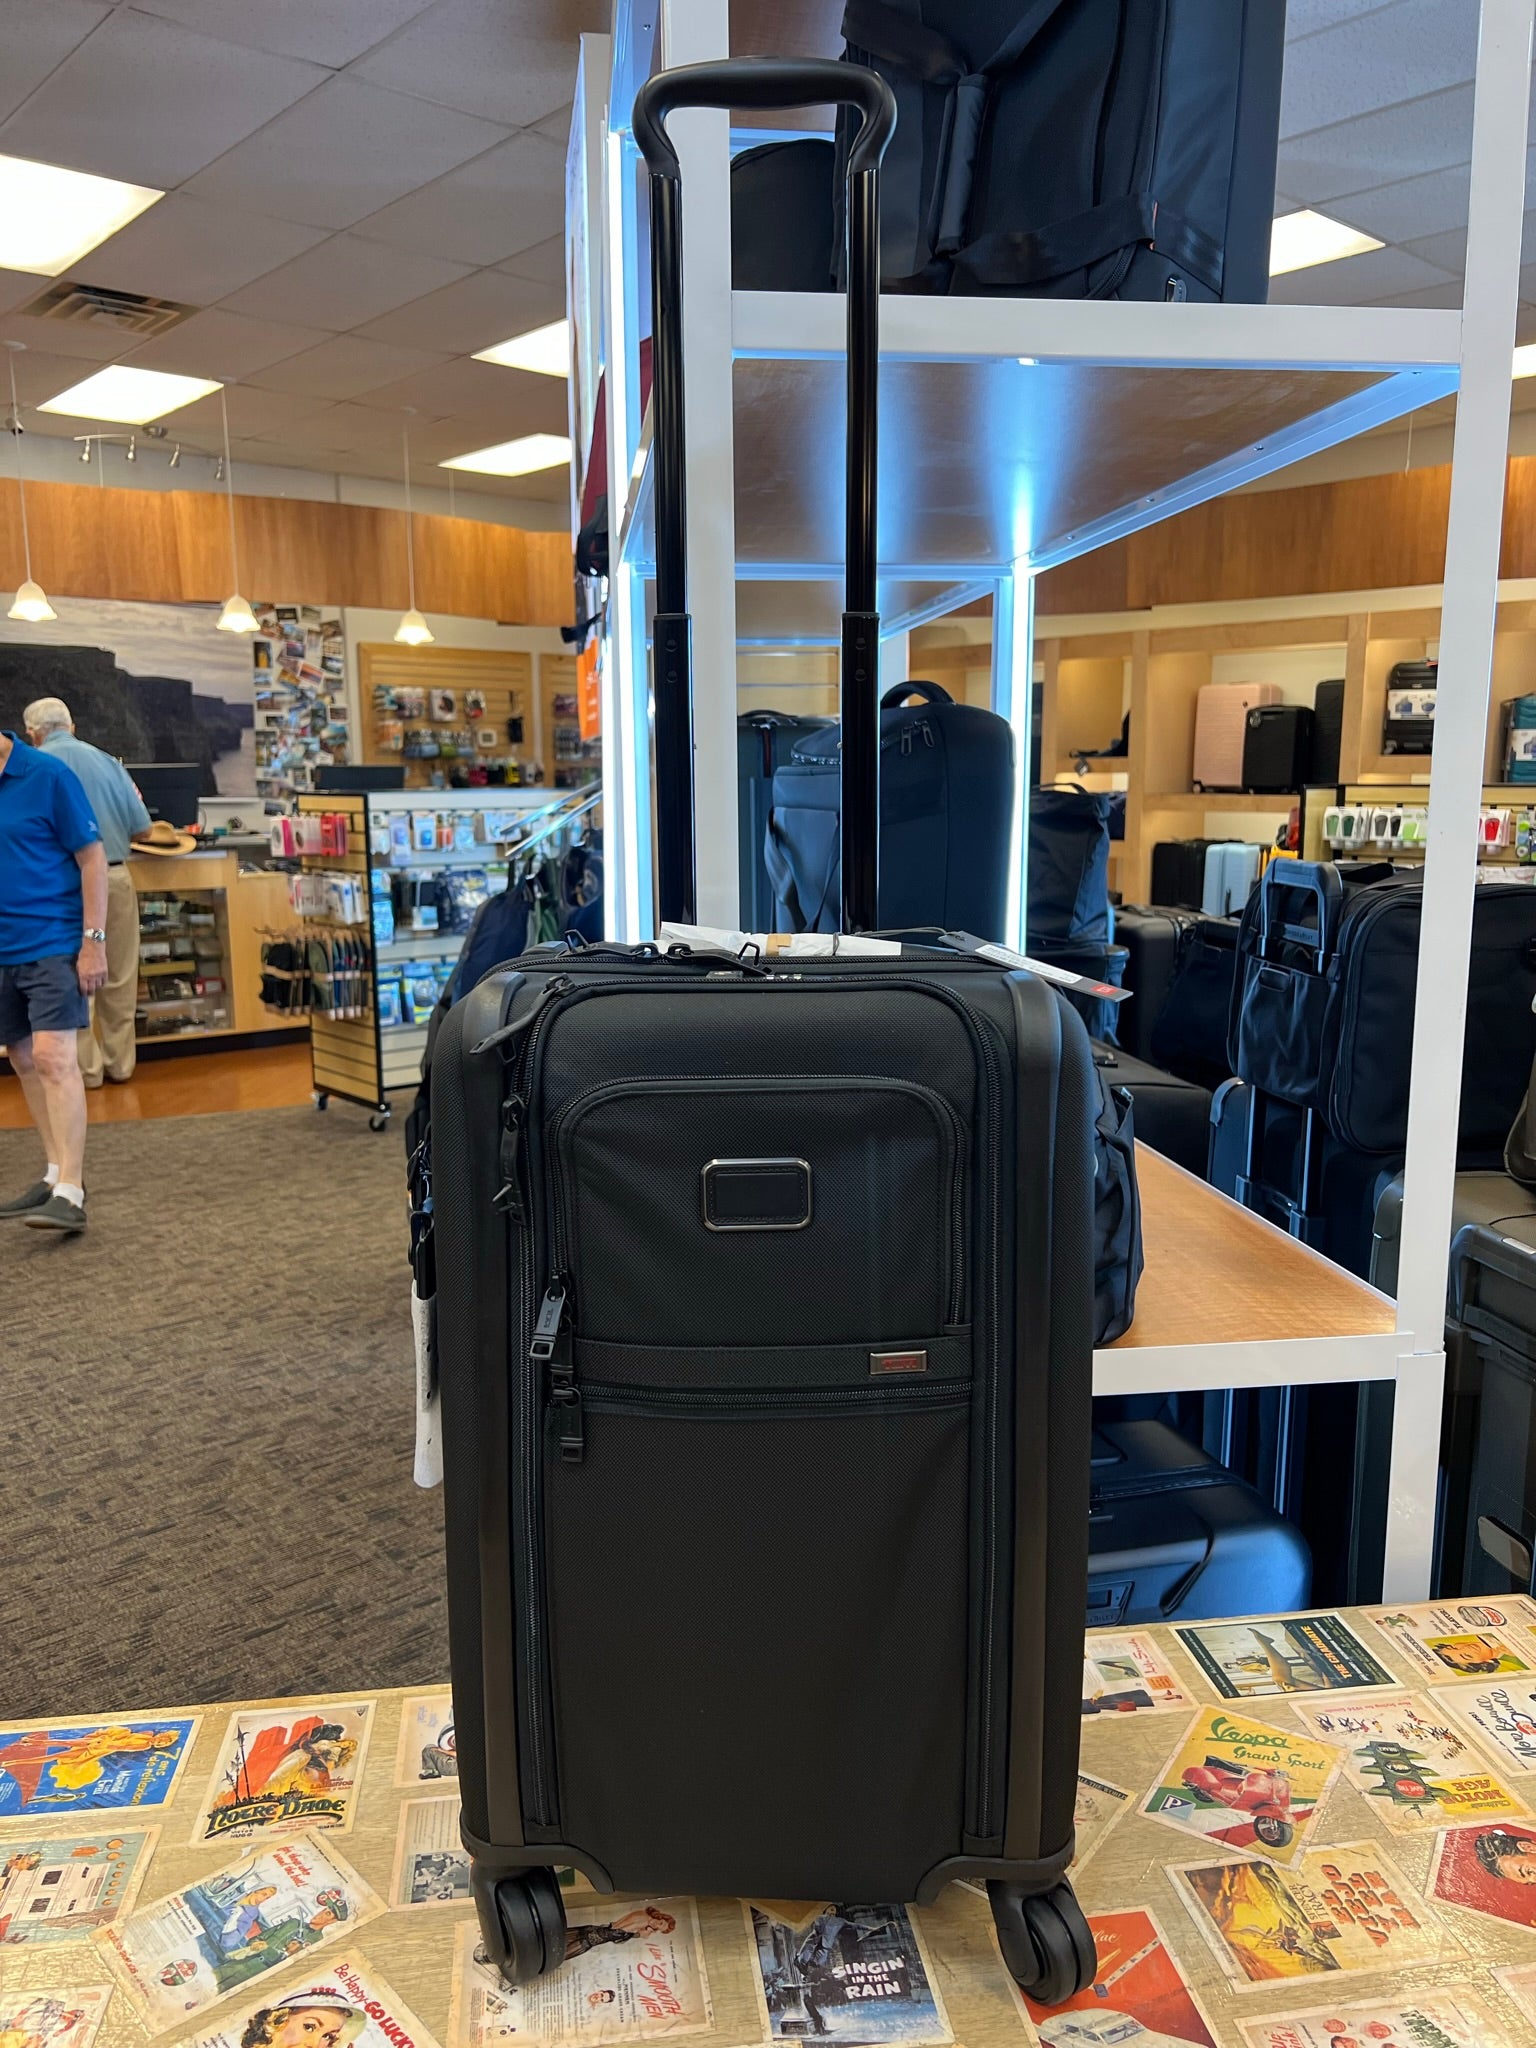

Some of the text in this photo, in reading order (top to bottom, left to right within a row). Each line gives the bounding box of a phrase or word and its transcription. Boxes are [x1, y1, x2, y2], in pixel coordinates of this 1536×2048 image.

[1301, 1625, 1340, 1663] GRADUATE
[1333, 1663, 1353, 1679] THE
[1206, 1716, 1290, 1748] Vespa
[150, 1747, 181, 1761] 7
[1232, 1746, 1326, 1770] Grand Sport
[1443, 1790, 1506, 1805] MOTOR
[1451, 1779, 1490, 1791] AGE
[1289, 1884, 1317, 1920] SPENCER
[1296, 1882, 1329, 1918] TRACY
[1321, 1864, 1389, 1948] VIEJO
[1321, 1889, 1355, 1925] EL
[1348, 1872, 1400, 1933] Y EL
[1363, 1870, 1421, 1929] MAR
[831, 1955, 906, 1979] SINGIN'
[851, 1973, 889, 1983] IN THE
[845, 1981, 901, 1999] RAIN
[334, 1963, 350, 1979] Be
[378, 2016, 416, 2048] LUCK
[637, 1995, 668, 2020] MEN
